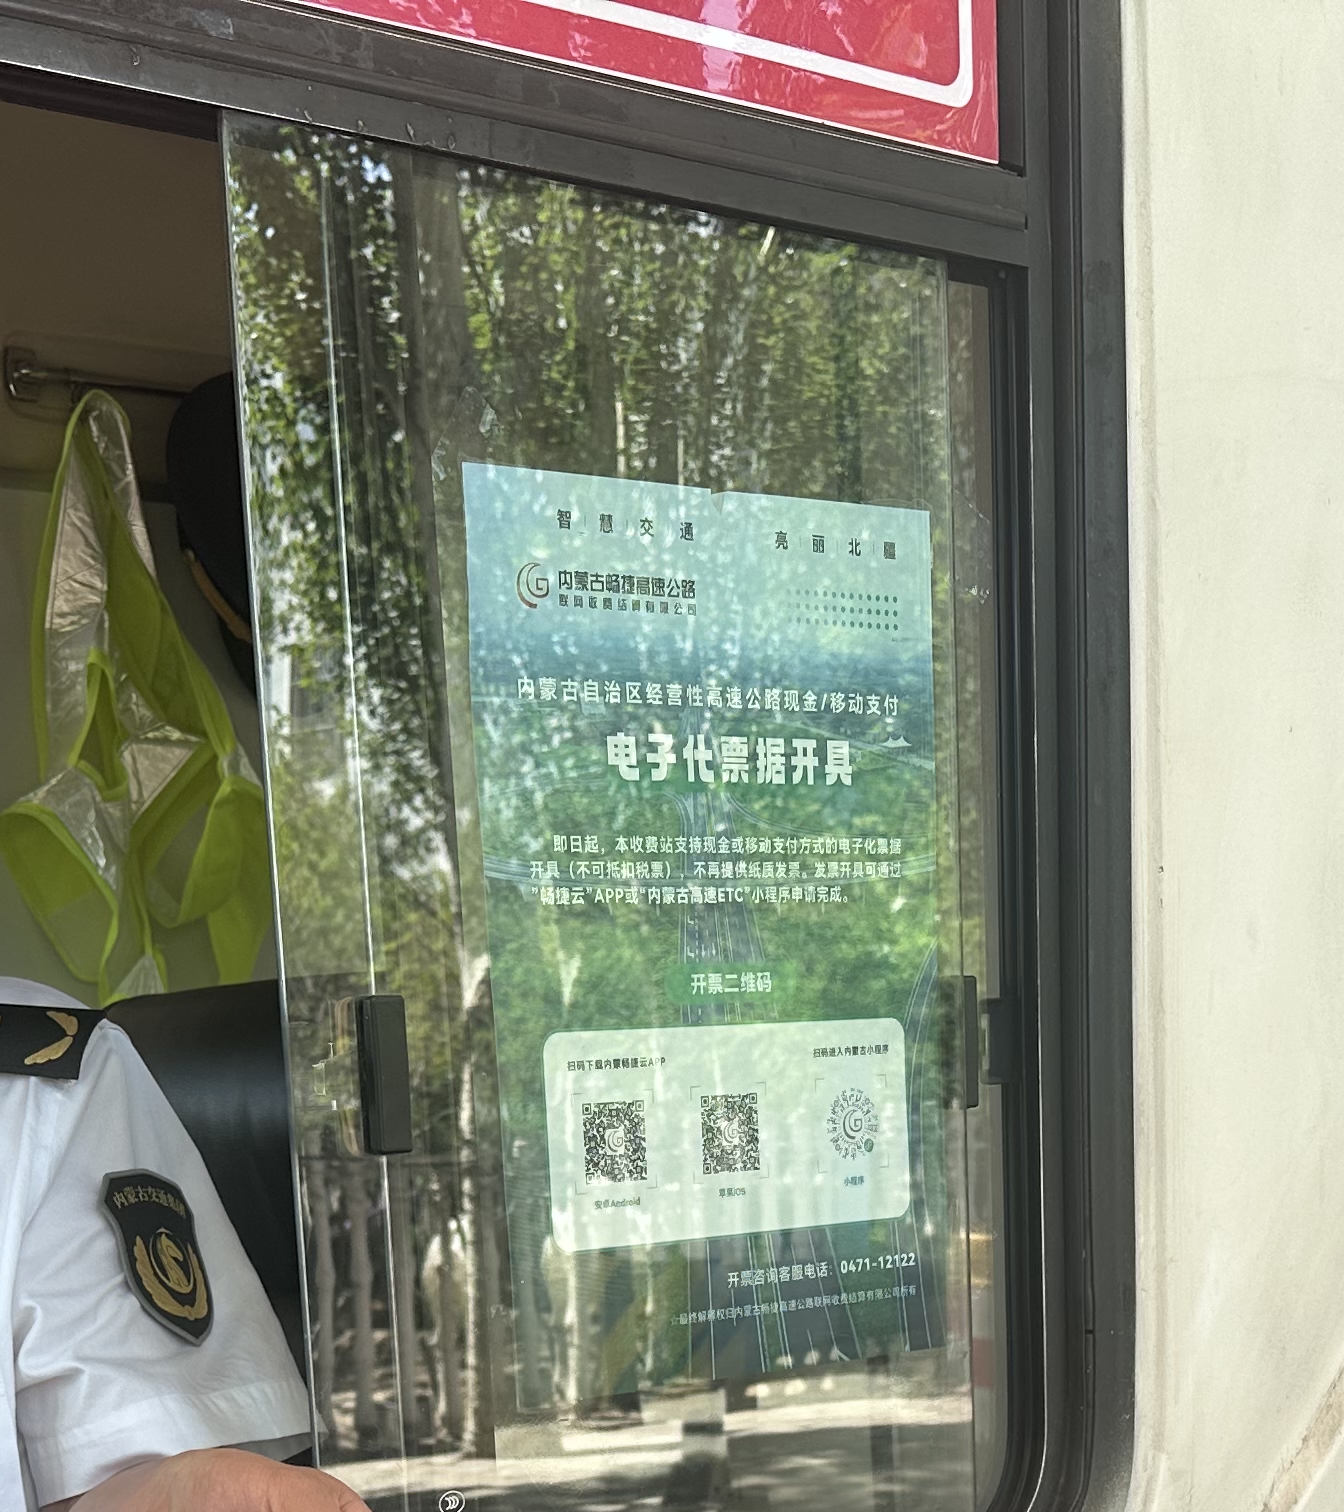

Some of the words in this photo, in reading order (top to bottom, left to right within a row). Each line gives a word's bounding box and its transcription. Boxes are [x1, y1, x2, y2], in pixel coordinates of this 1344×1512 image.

[555, 508, 695, 543] 智慧交通
[557, 569, 697, 600] 内蒙古畅捷高速公路
[516, 677, 900, 718] 内蒙古自治区经营性高速公路现金/移动支付
[605, 730, 855, 788] 电子化票据开具
[690, 971, 773, 997] 开票二维码
